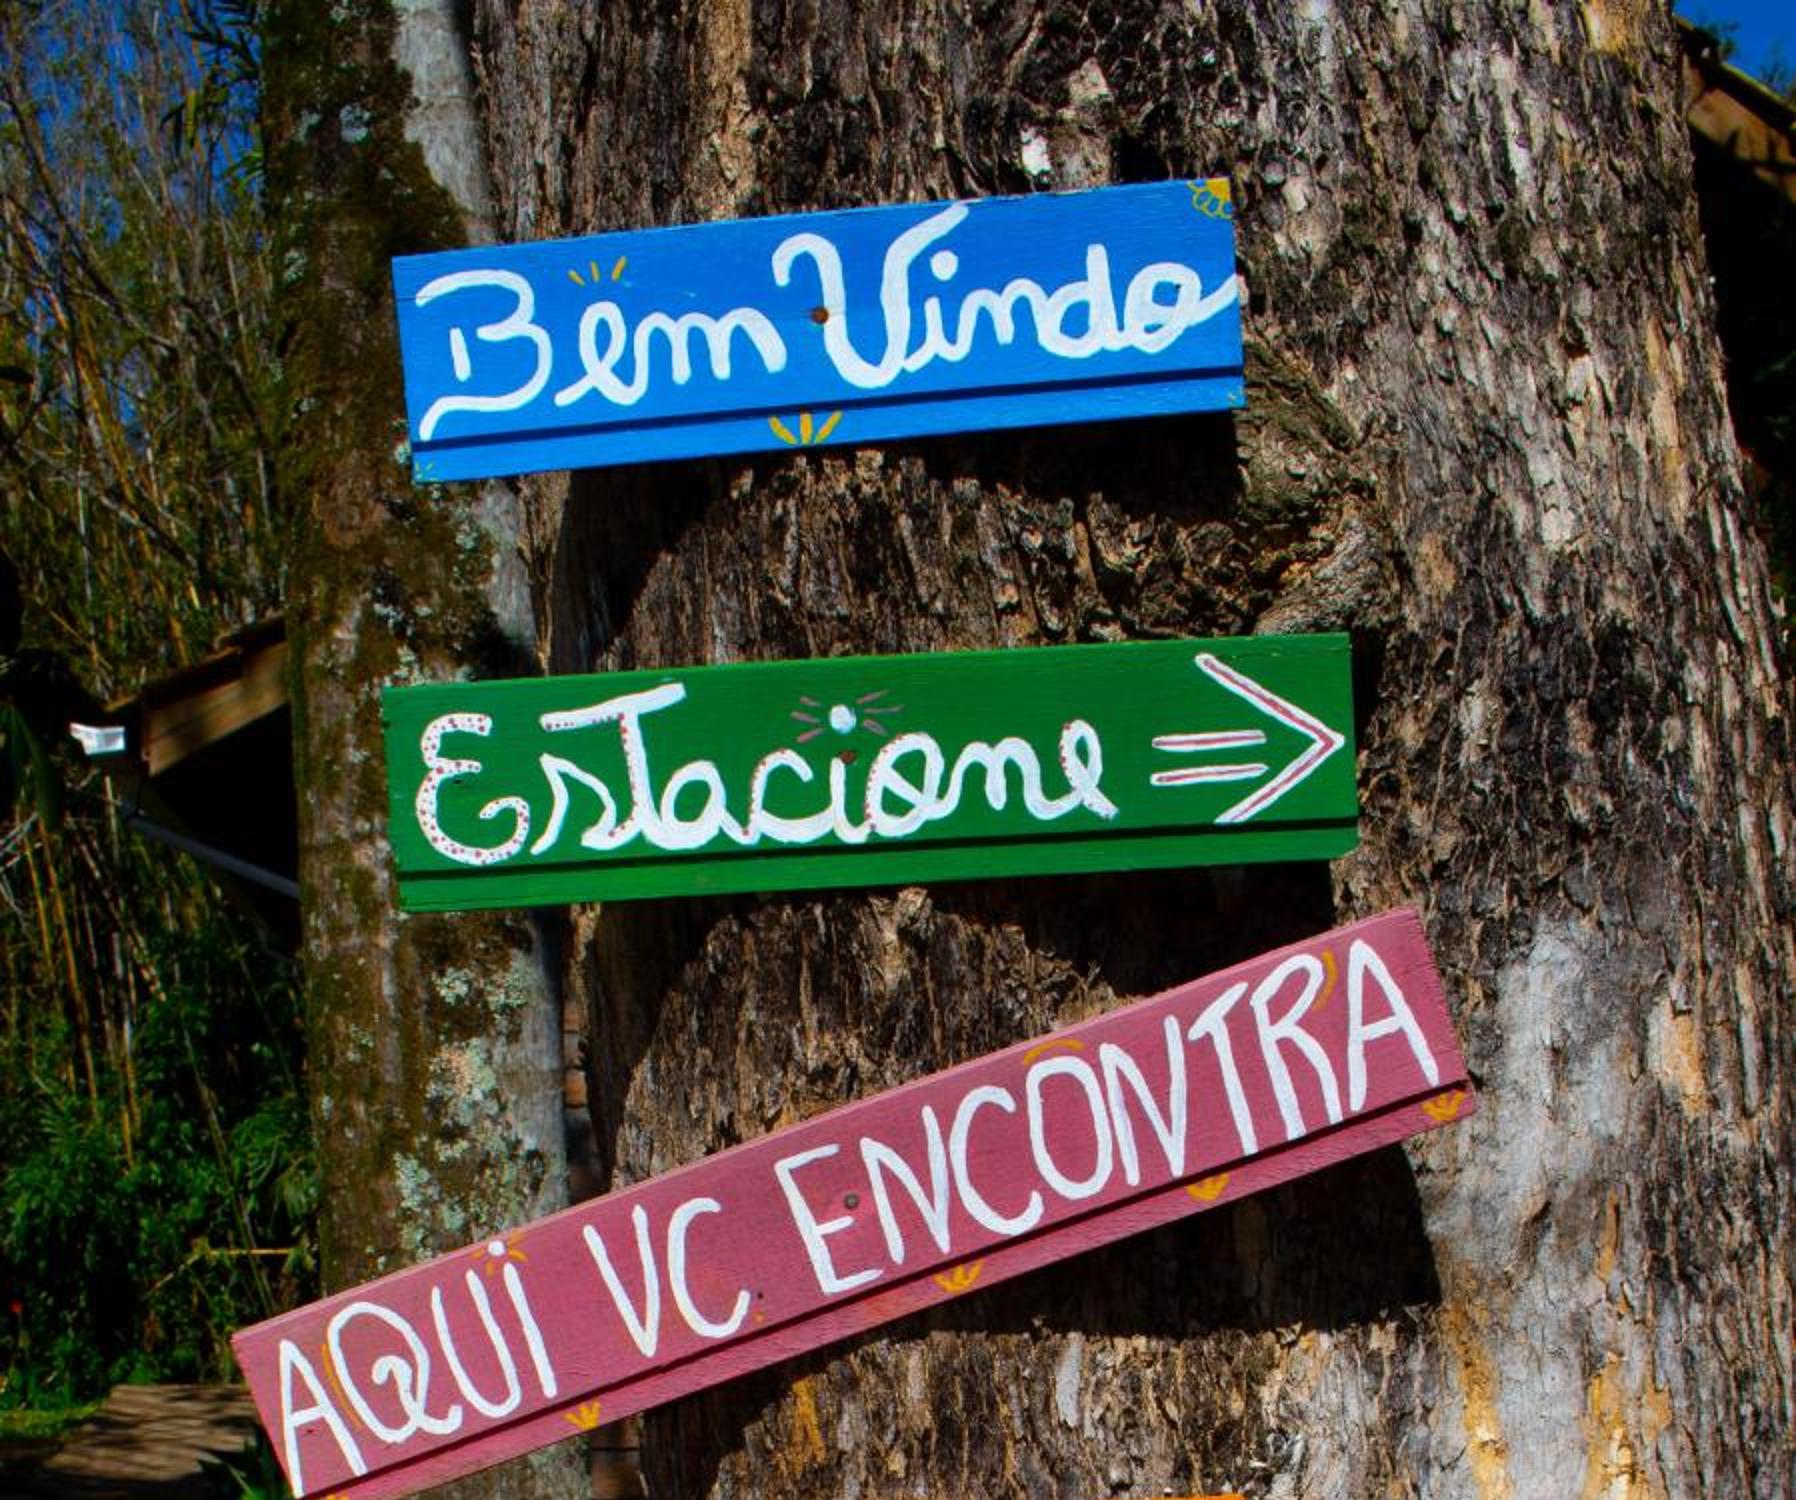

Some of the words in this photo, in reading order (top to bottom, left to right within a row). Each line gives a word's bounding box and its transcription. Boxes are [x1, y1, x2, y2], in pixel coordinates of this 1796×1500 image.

[416, 269, 787, 441] Bem
[772, 203, 1239, 389] Vindo
[583, 1197, 752, 1357] VC
[776, 938, 1441, 1296] ENCONTRA
